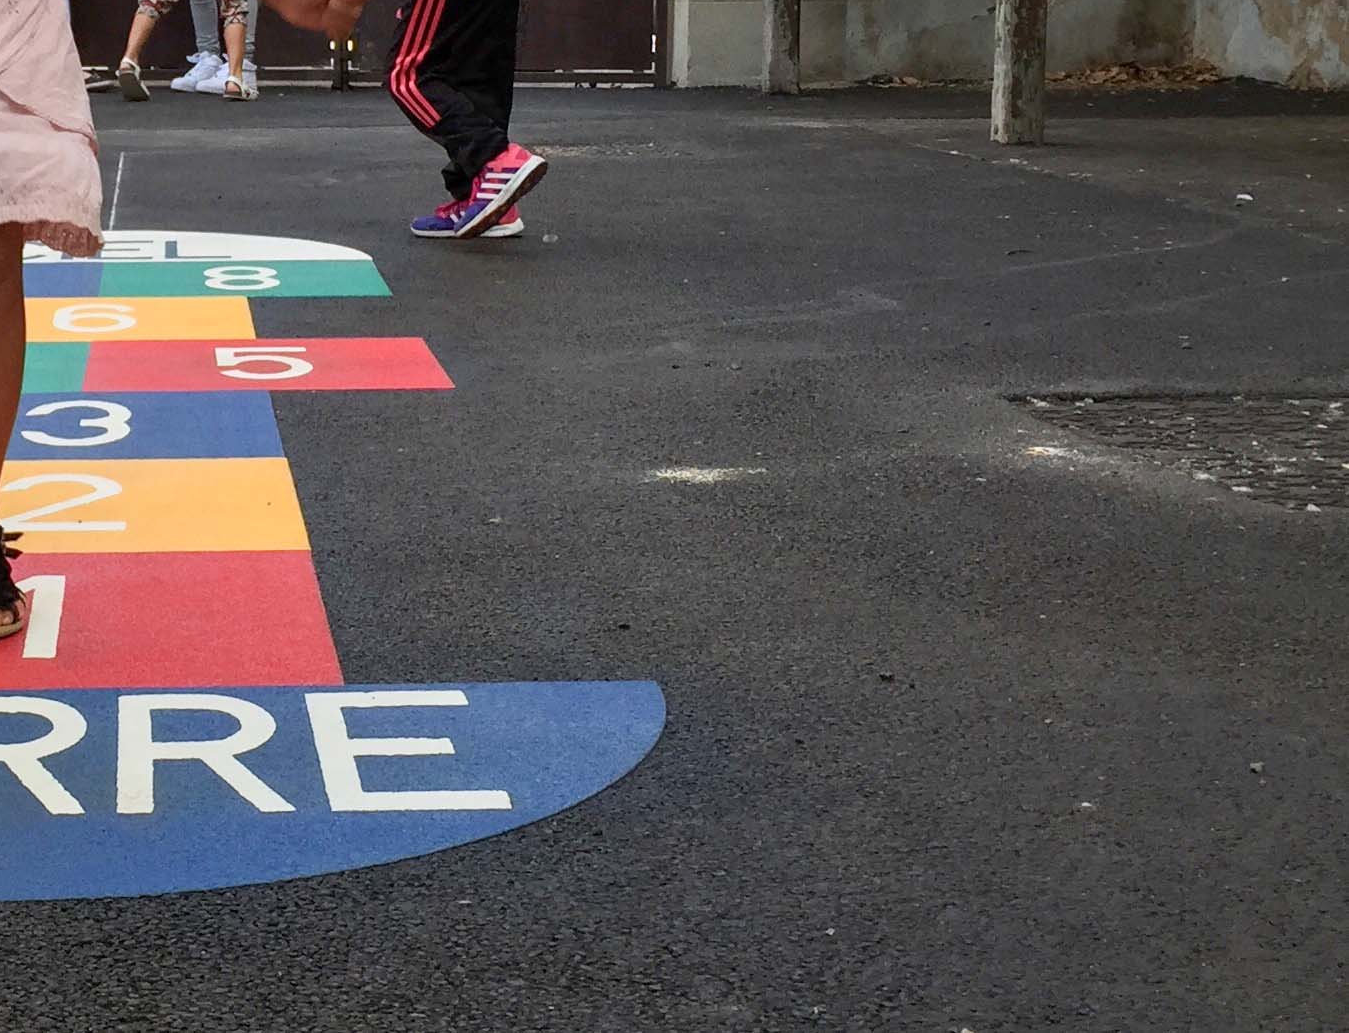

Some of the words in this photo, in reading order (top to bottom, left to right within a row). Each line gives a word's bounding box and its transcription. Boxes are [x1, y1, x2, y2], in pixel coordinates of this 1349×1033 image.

[23, 240, 231, 260] EL
[204, 266, 280, 291] 8
[53, 304, 136, 333] 6
[215, 346, 314, 380] 5
[21, 400, 132, 446] 3
[13, 574, 66, 659] 1
